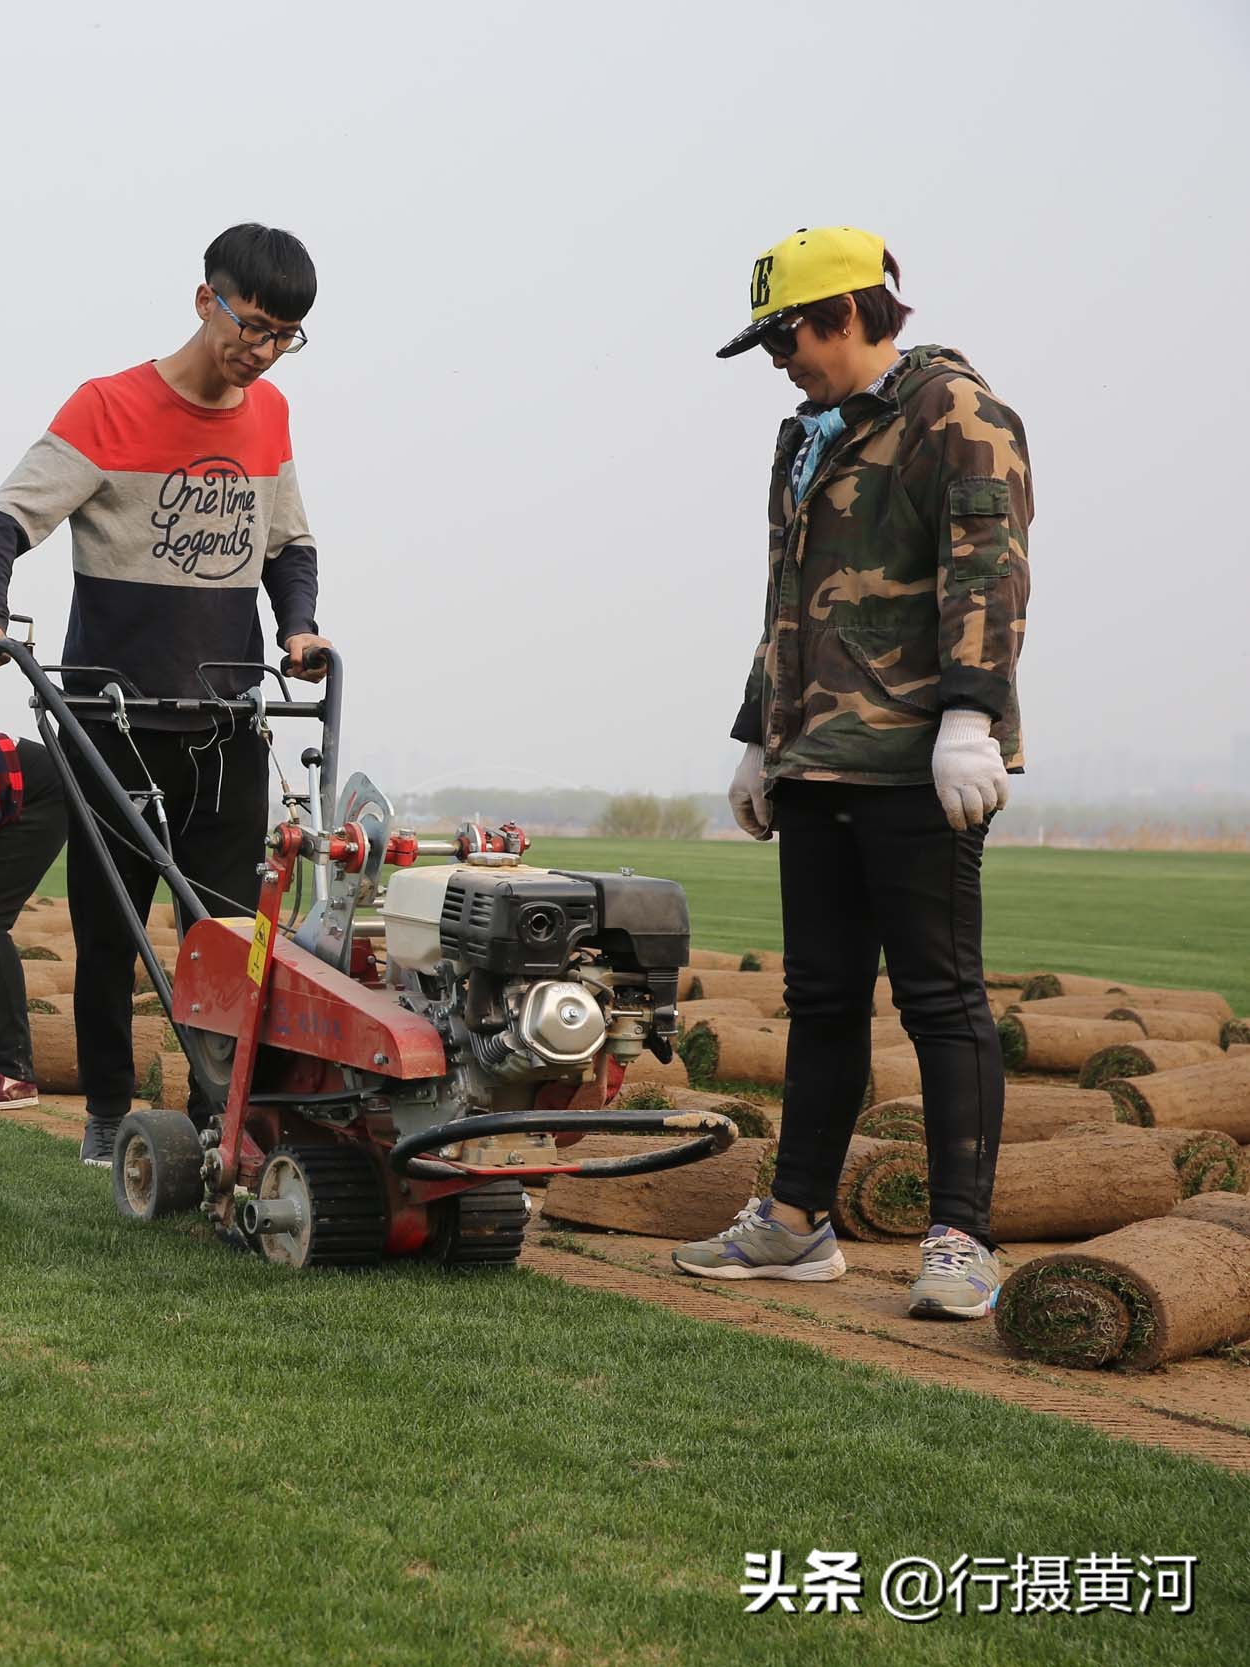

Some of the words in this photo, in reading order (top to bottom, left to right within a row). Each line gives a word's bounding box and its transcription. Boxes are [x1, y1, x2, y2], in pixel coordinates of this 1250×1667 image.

[159, 468, 219, 515] One
[203, 468, 256, 518] Time
[151, 512, 253, 575] Legends
